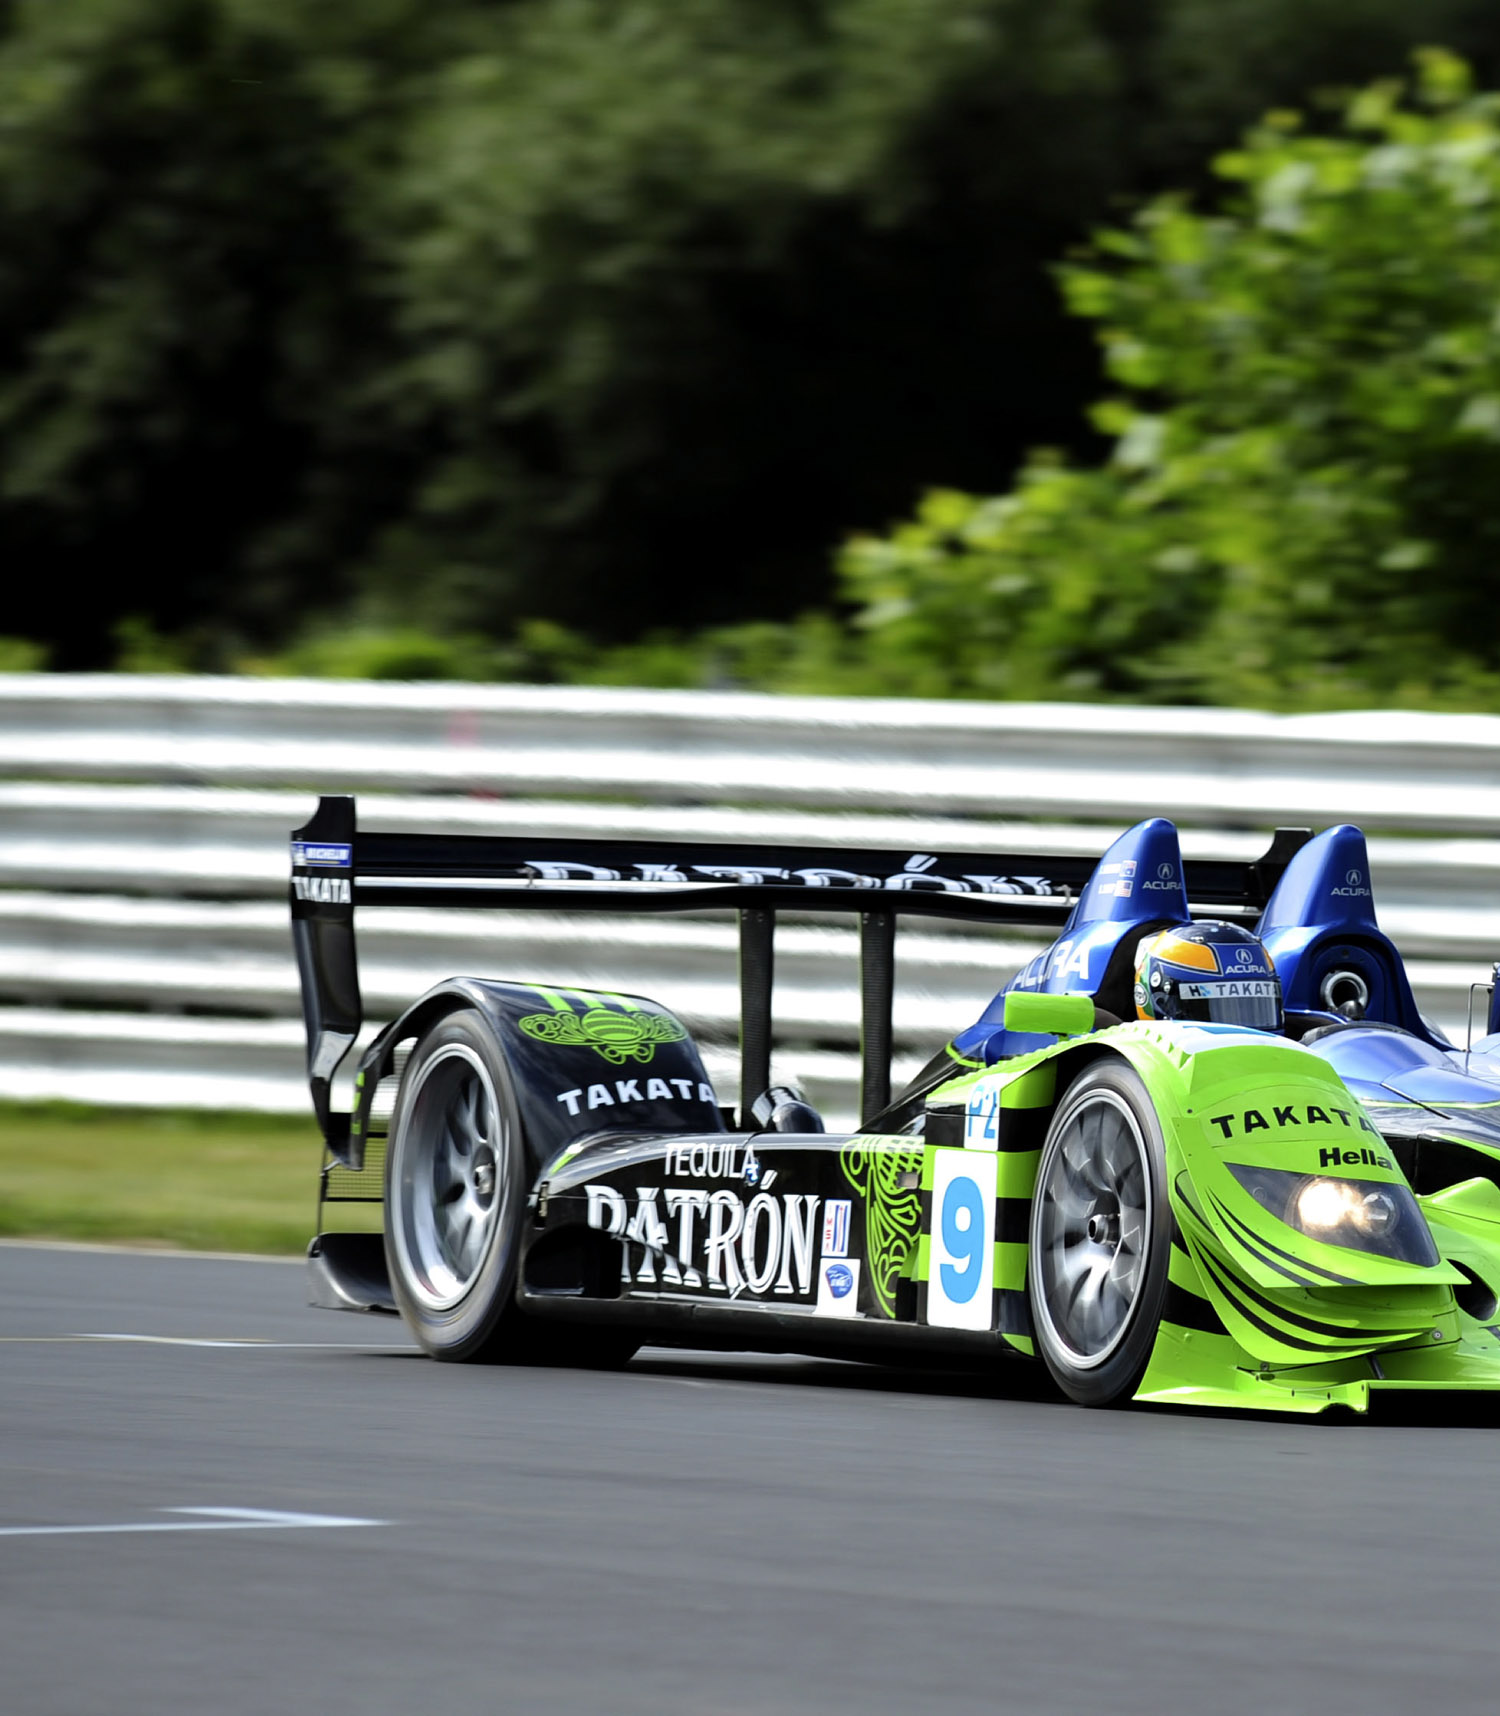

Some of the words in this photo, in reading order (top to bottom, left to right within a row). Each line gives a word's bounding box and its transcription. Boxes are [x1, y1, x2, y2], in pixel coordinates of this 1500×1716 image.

[292, 875, 352, 904] TAKATA
[1330, 887, 1370, 896] ACURA
[1225, 964, 1267, 975] ACURA
[556, 1078, 718, 1116] TAKATA
[968, 1084, 998, 1139] P2
[1210, 1105, 1380, 1139] TAKATA
[664, 1142, 759, 1180] TEQUILA
[1318, 1147, 1394, 1171] Hella
[584, 1169, 821, 1300] PATRÓN
[939, 1176, 985, 1304] 9
